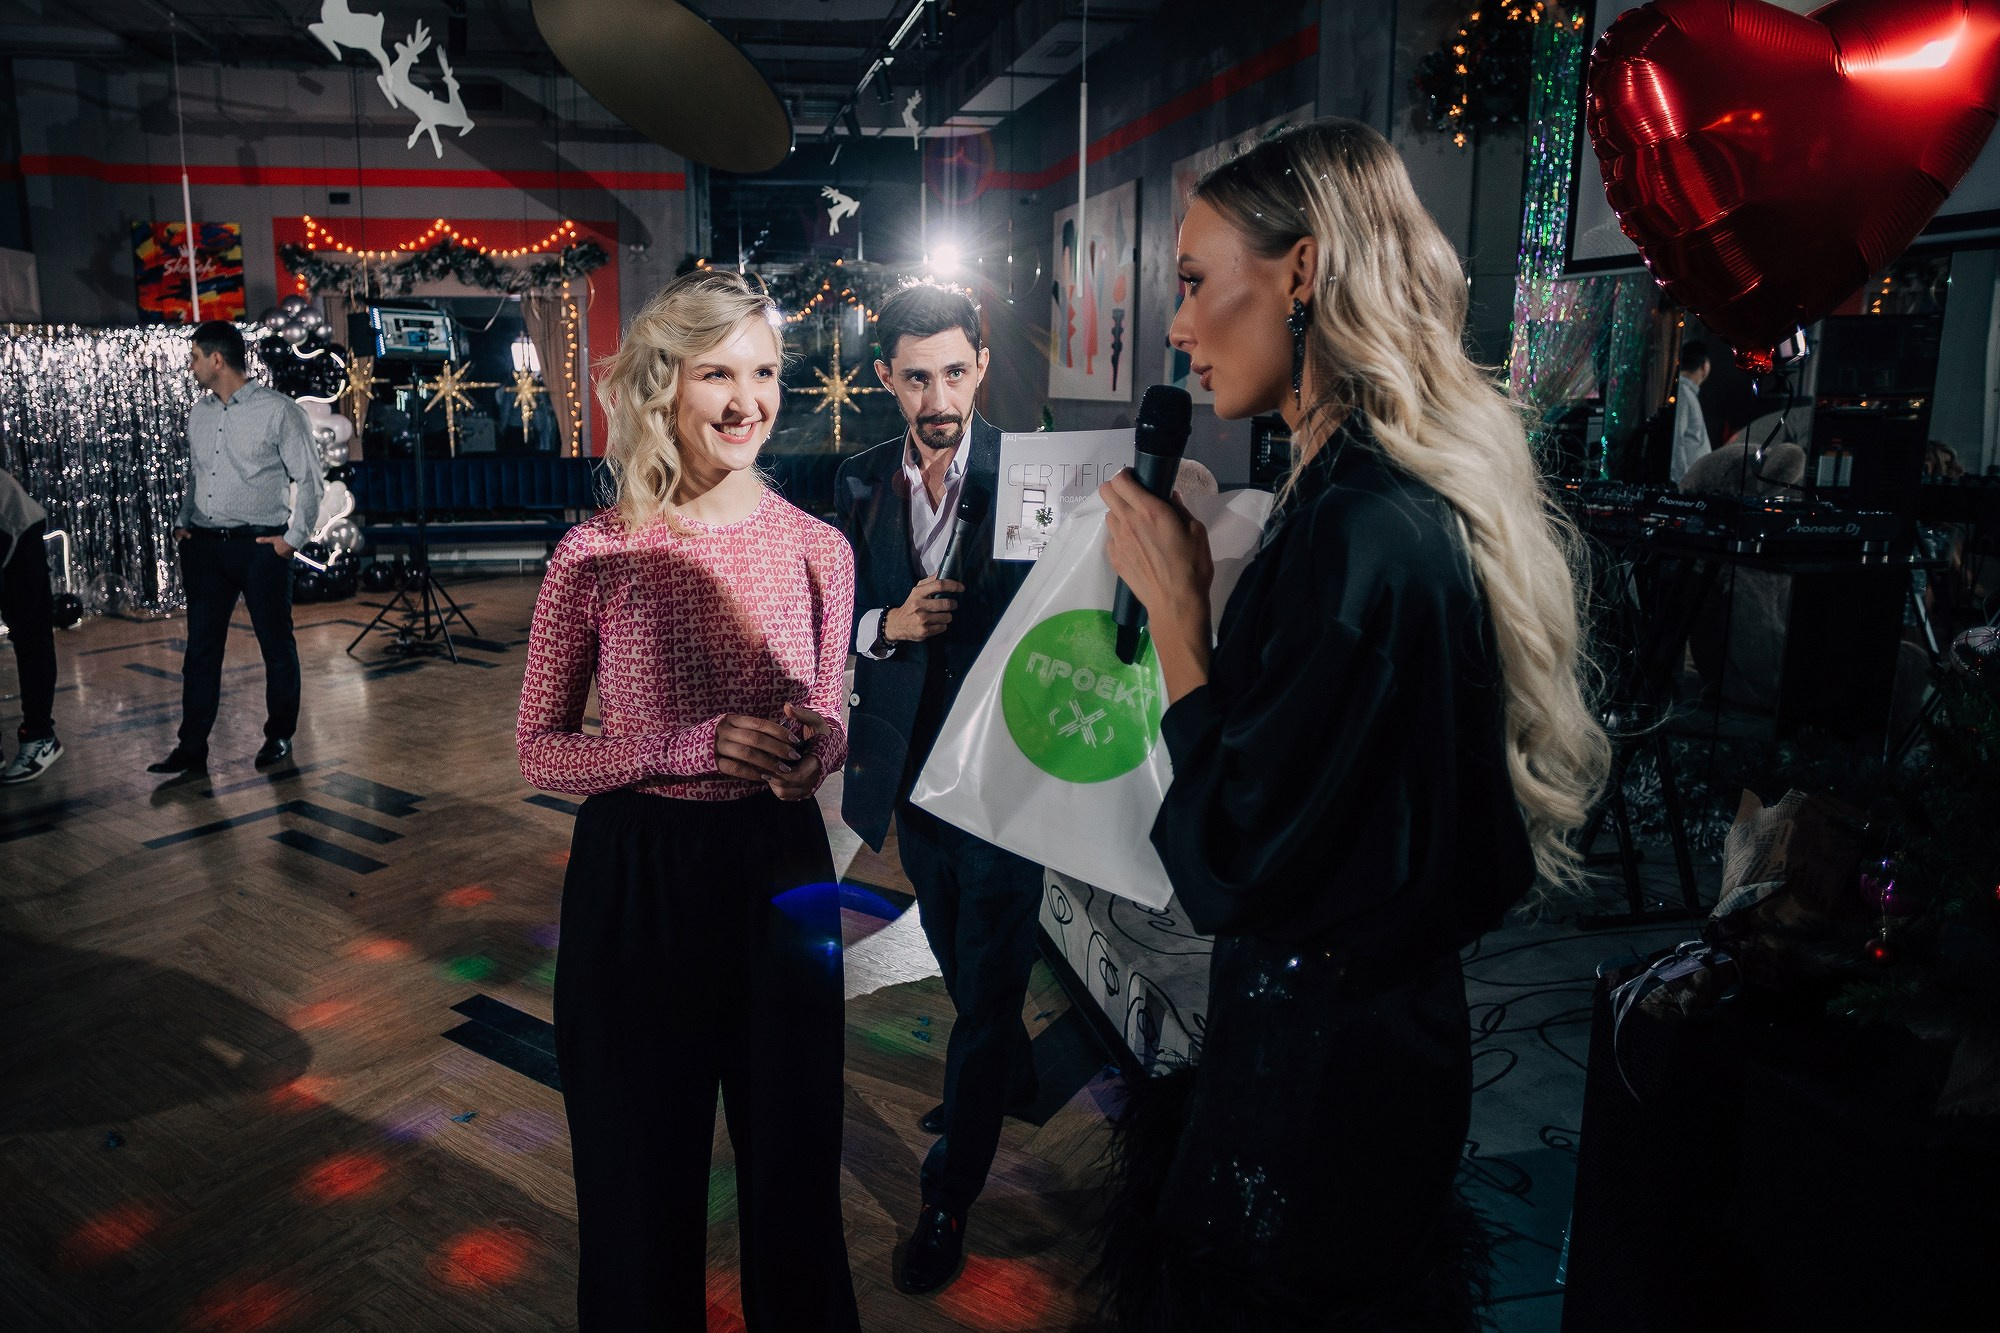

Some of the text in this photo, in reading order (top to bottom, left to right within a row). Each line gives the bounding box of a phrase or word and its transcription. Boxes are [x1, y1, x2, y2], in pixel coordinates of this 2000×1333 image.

[163, 257, 217, 280] Skech
[1007, 463, 1127, 487] CERTIFIC
[1059, 495, 1088, 504] ПОДАРО
[1657, 496, 1694, 507] Pioneer
[1786, 523, 1843, 533] Pioneer
[1026, 651, 1157, 713] ПРОЕКТ
